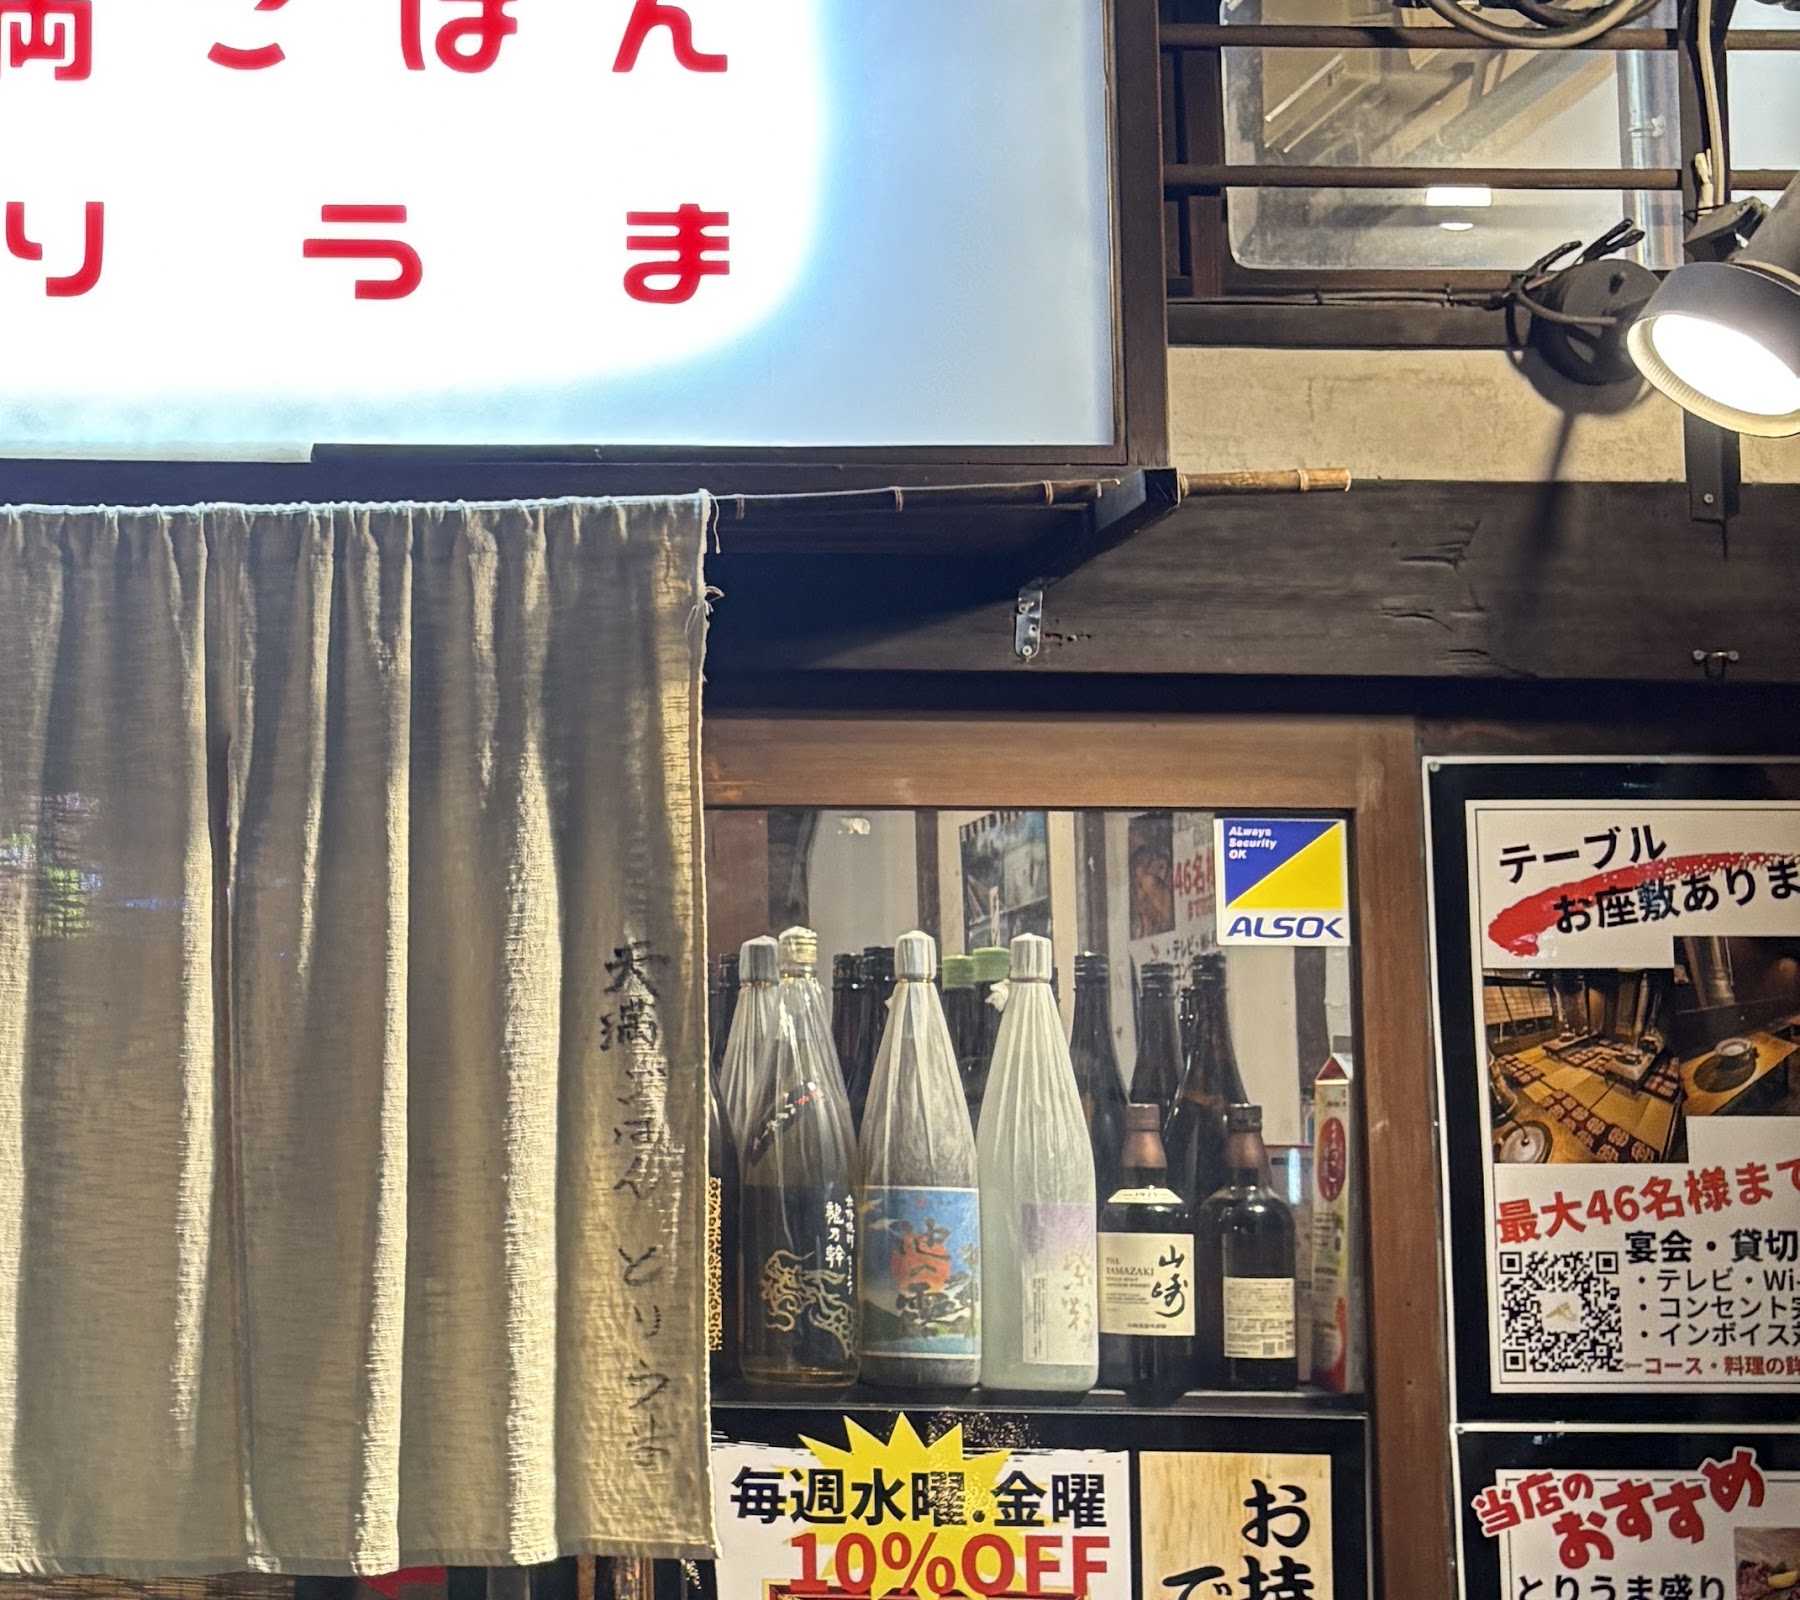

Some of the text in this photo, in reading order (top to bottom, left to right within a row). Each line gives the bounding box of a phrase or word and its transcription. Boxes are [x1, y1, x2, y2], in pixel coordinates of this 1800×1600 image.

[1229, 838, 1277, 850] Security
[1229, 850, 1247, 860] OK
[1500, 824, 1668, 884] テーブル
[1226, 916, 1345, 939] ALSOK
[1625, 1228, 1798, 1264] 宴会・貸切
[1151, 1245, 1188, 1318] 山崎
[1474, 1472, 1594, 1534] 当店の
[1553, 1450, 1766, 1570] おすすめ
[789, 1531, 1110, 1597] 10%OFF
